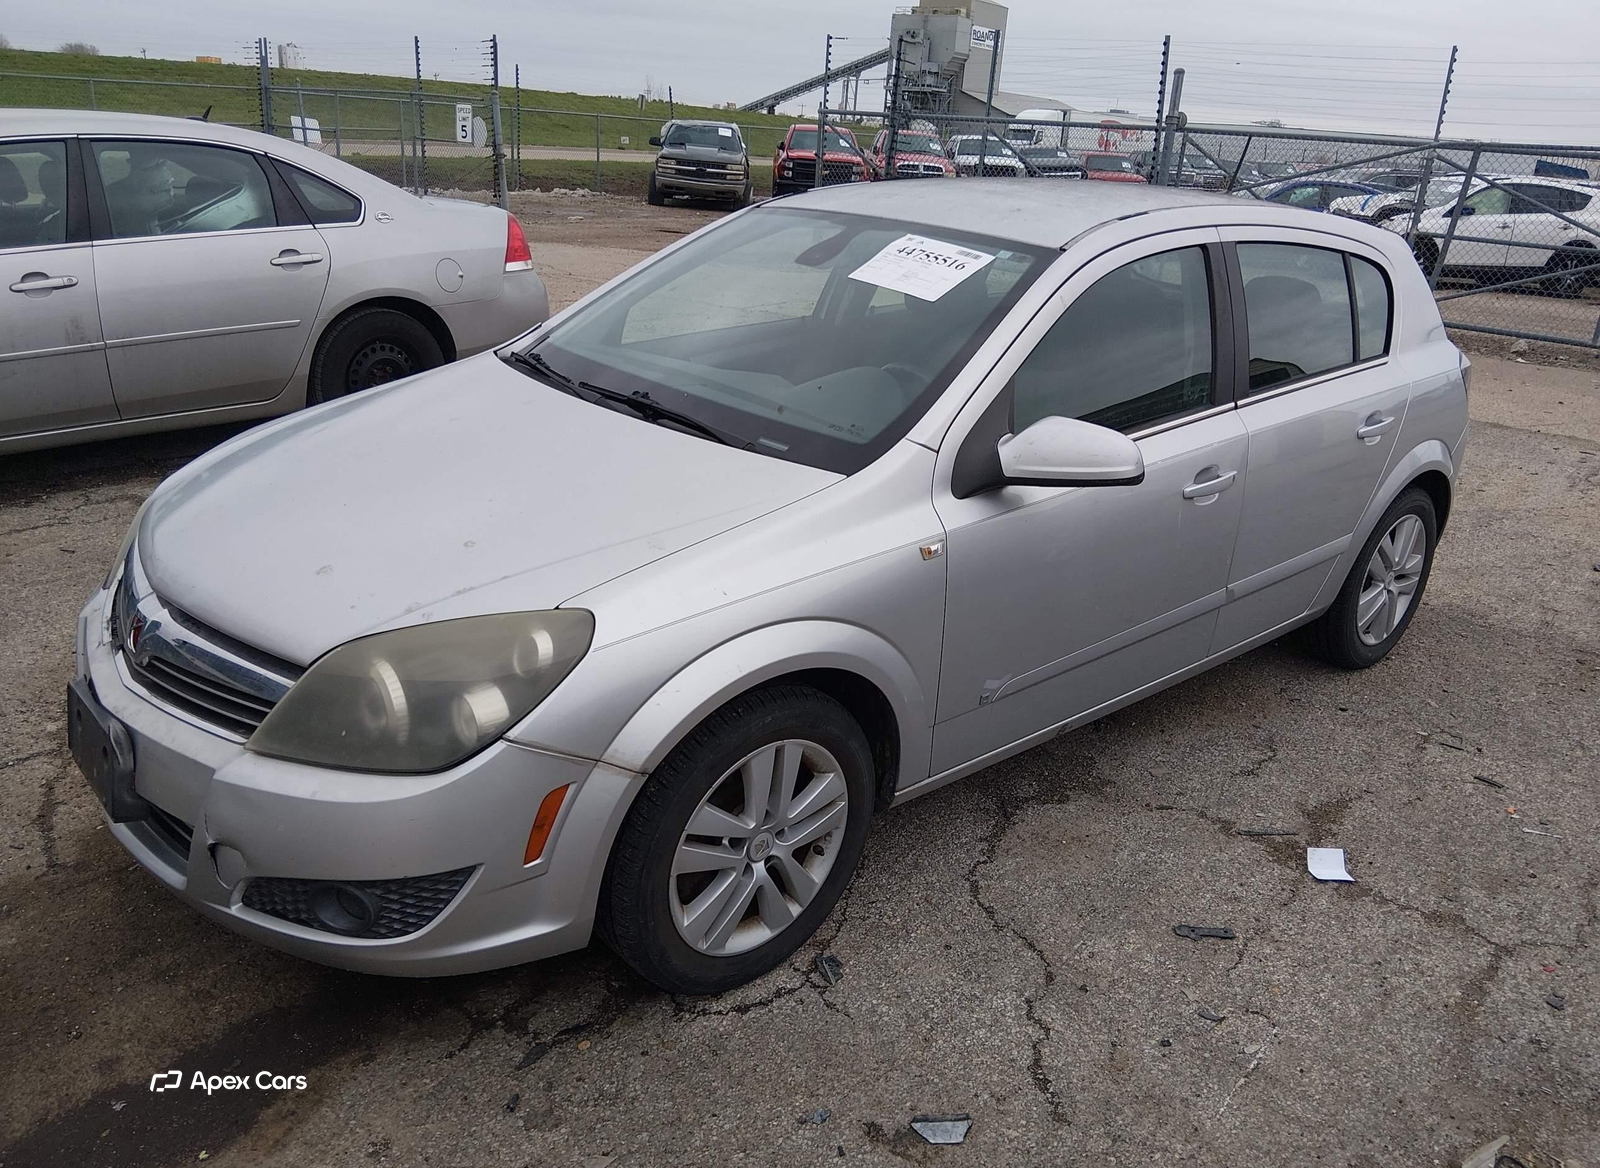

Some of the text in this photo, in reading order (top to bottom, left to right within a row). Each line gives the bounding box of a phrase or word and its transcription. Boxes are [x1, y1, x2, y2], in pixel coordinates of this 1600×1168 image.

[973, 30, 995, 42] ROANO
[461, 125, 468, 139] 5
[896, 246, 968, 271] 44755516
